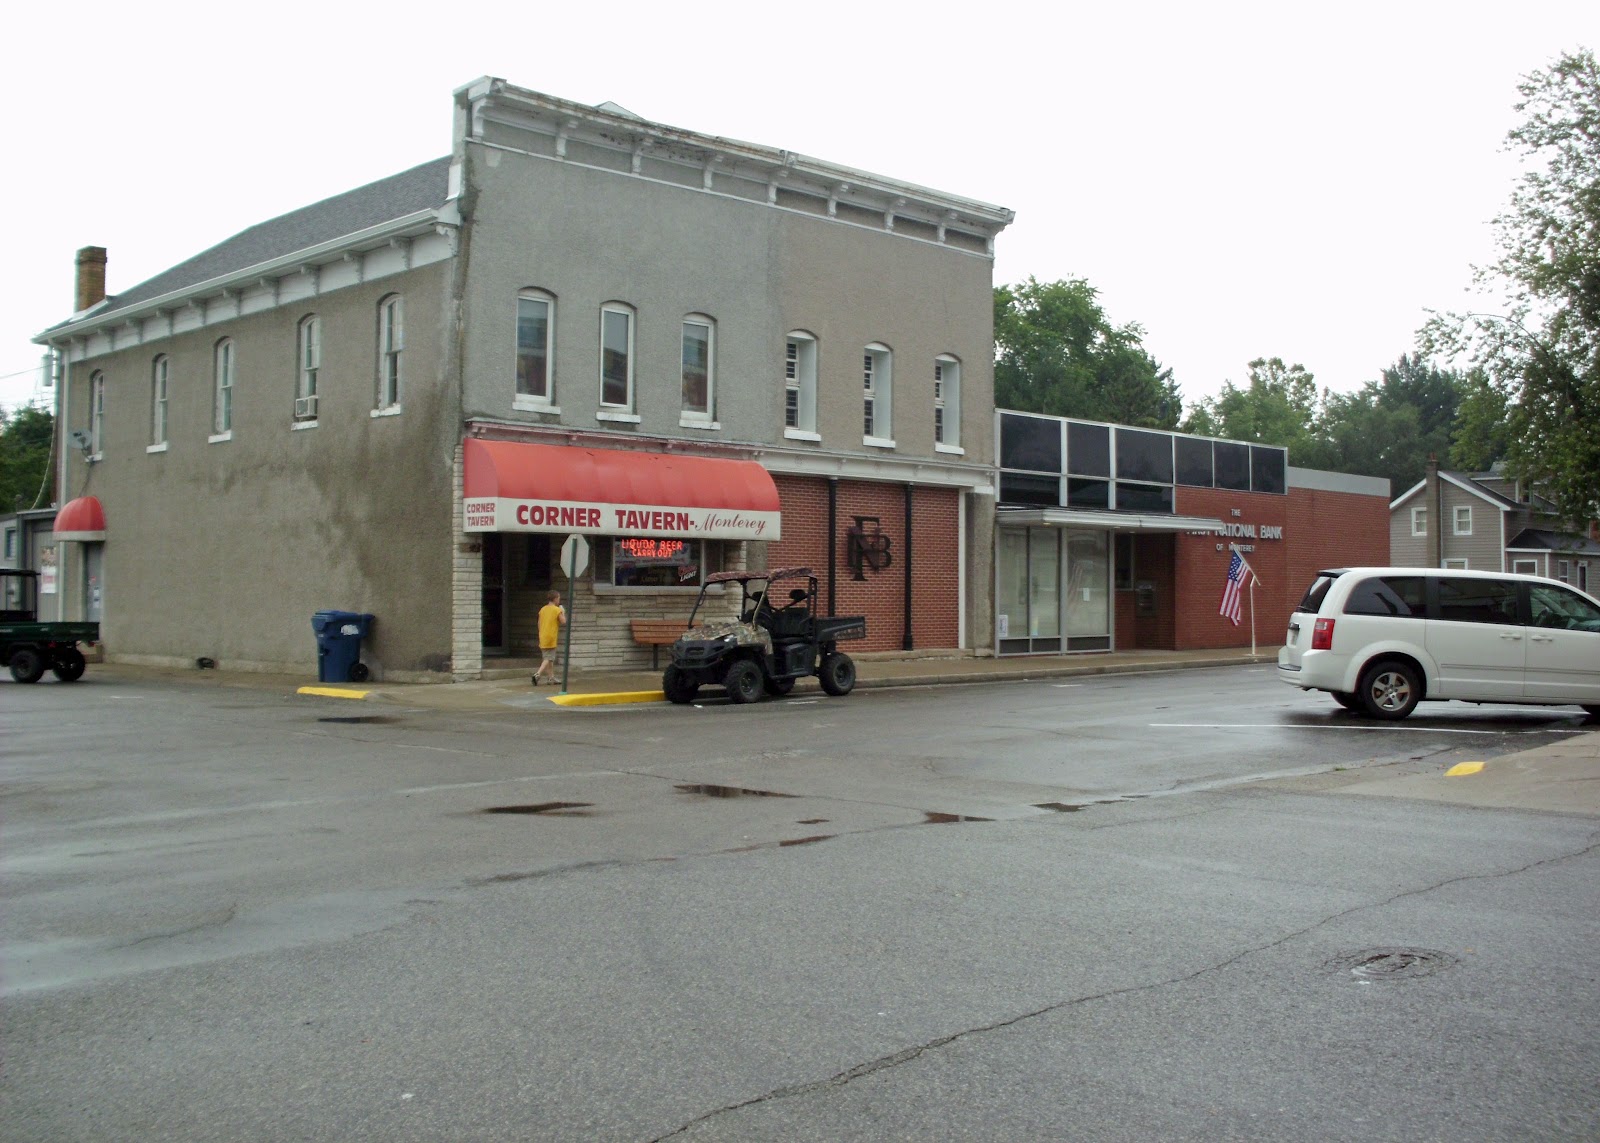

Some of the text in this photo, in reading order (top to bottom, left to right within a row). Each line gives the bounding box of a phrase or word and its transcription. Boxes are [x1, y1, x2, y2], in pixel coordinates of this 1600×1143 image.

[467, 503, 495, 513] CORNER
[1231, 508, 1241, 516] THE
[467, 516, 495, 527] TAVERN
[516, 504, 601, 528] CORNER
[694, 513, 766, 535] Monterey
[1260, 525, 1283, 539] BANK
[621, 539, 683, 551] LIQUOR BEER
[1216, 543, 1223, 551] OF
[632, 548, 673, 558] CARRY OUT
